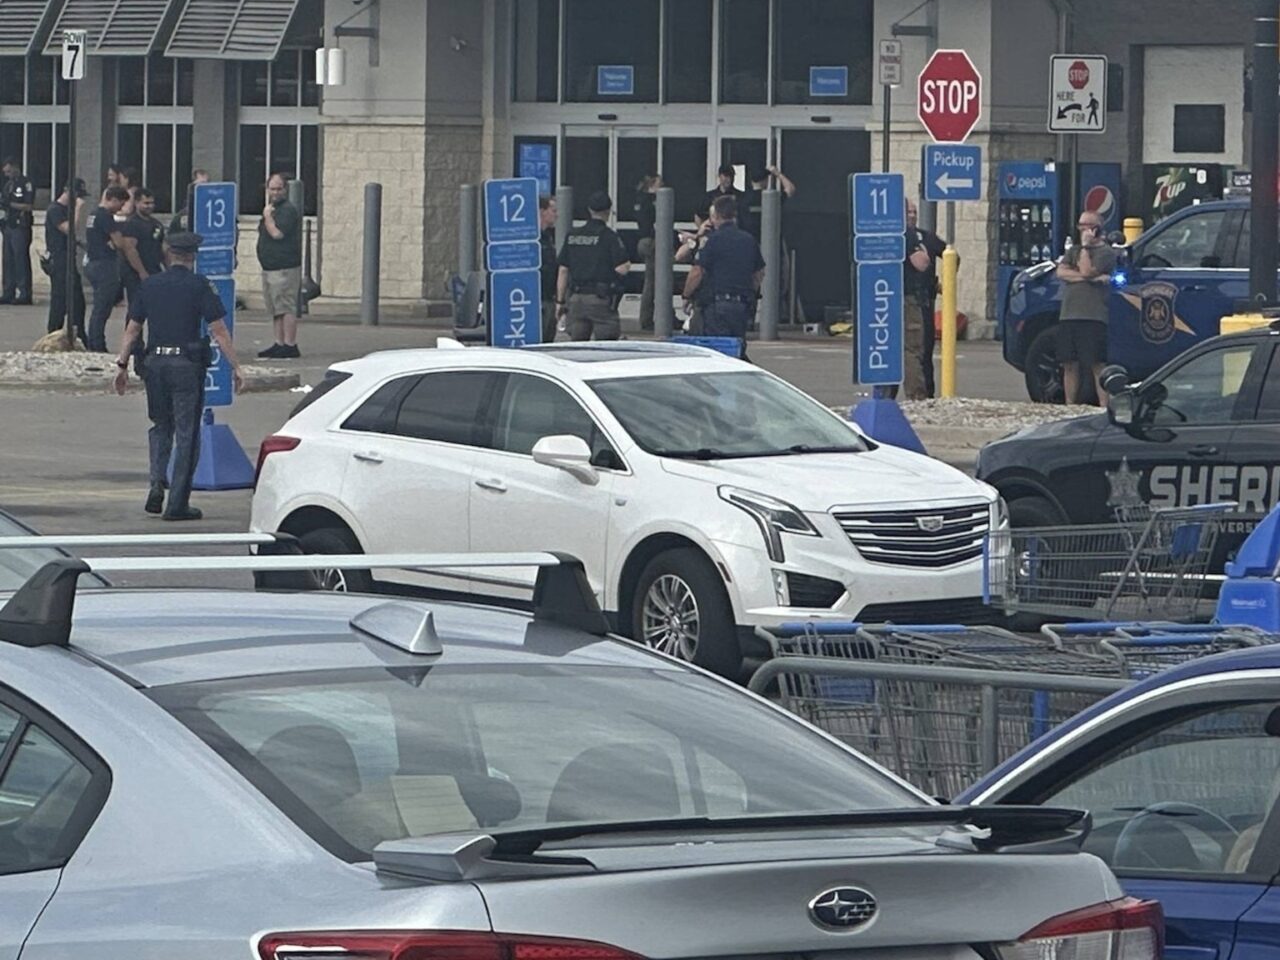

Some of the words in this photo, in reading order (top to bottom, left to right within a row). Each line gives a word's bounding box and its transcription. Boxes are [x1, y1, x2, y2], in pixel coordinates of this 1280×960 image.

[68, 45, 79, 78] 7
[1070, 69, 1089, 81] STOP
[922, 79, 977, 114] STOP
[1057, 91, 1075, 101] HERE
[1072, 113, 1086, 123] FOR
[933, 151, 975, 171] Pickup
[1018, 175, 1047, 189] pepsi
[206, 198, 226, 228] 13
[499, 193, 525, 222] 12
[870, 188, 888, 215] 11
[504, 288, 532, 347] kup
[868, 279, 895, 369] Pickup
